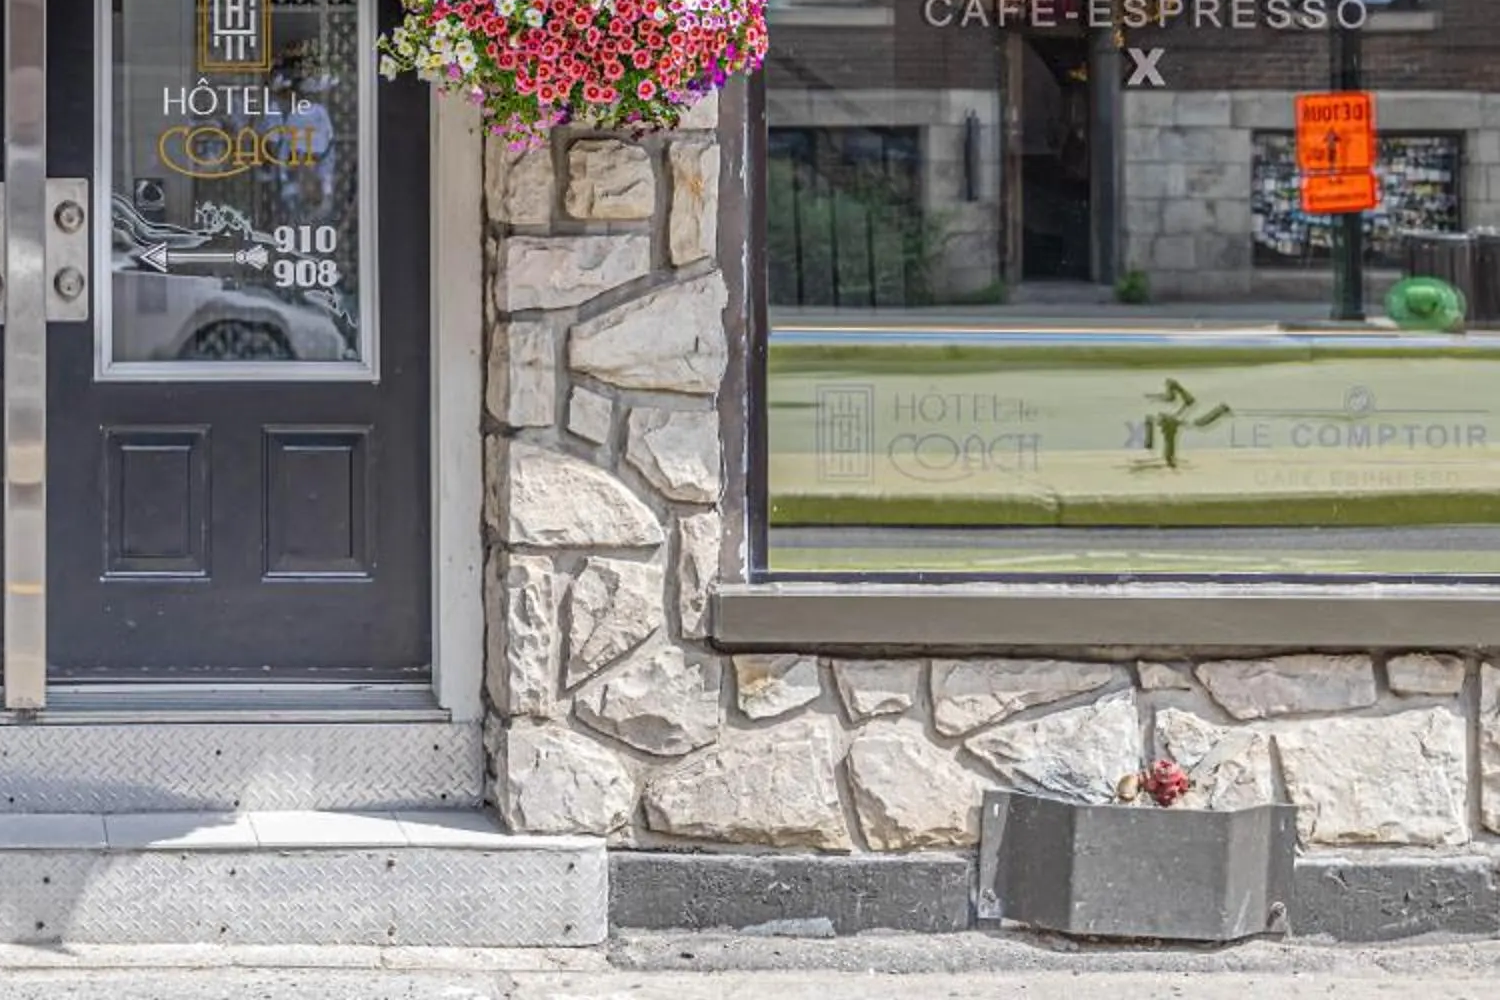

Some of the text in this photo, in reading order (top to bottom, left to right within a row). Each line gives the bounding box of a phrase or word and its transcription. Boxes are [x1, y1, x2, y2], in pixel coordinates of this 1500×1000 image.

[162, 77, 311, 116] HÔTEL le
[159, 126, 316, 179] COACH
[273, 225, 337, 253] 910
[273, 259, 338, 287] 908
[894, 384, 1004, 423] HÔTEL
[1230, 423, 1489, 449] LE COMPTOIR
[887, 433, 1042, 483] COACH
